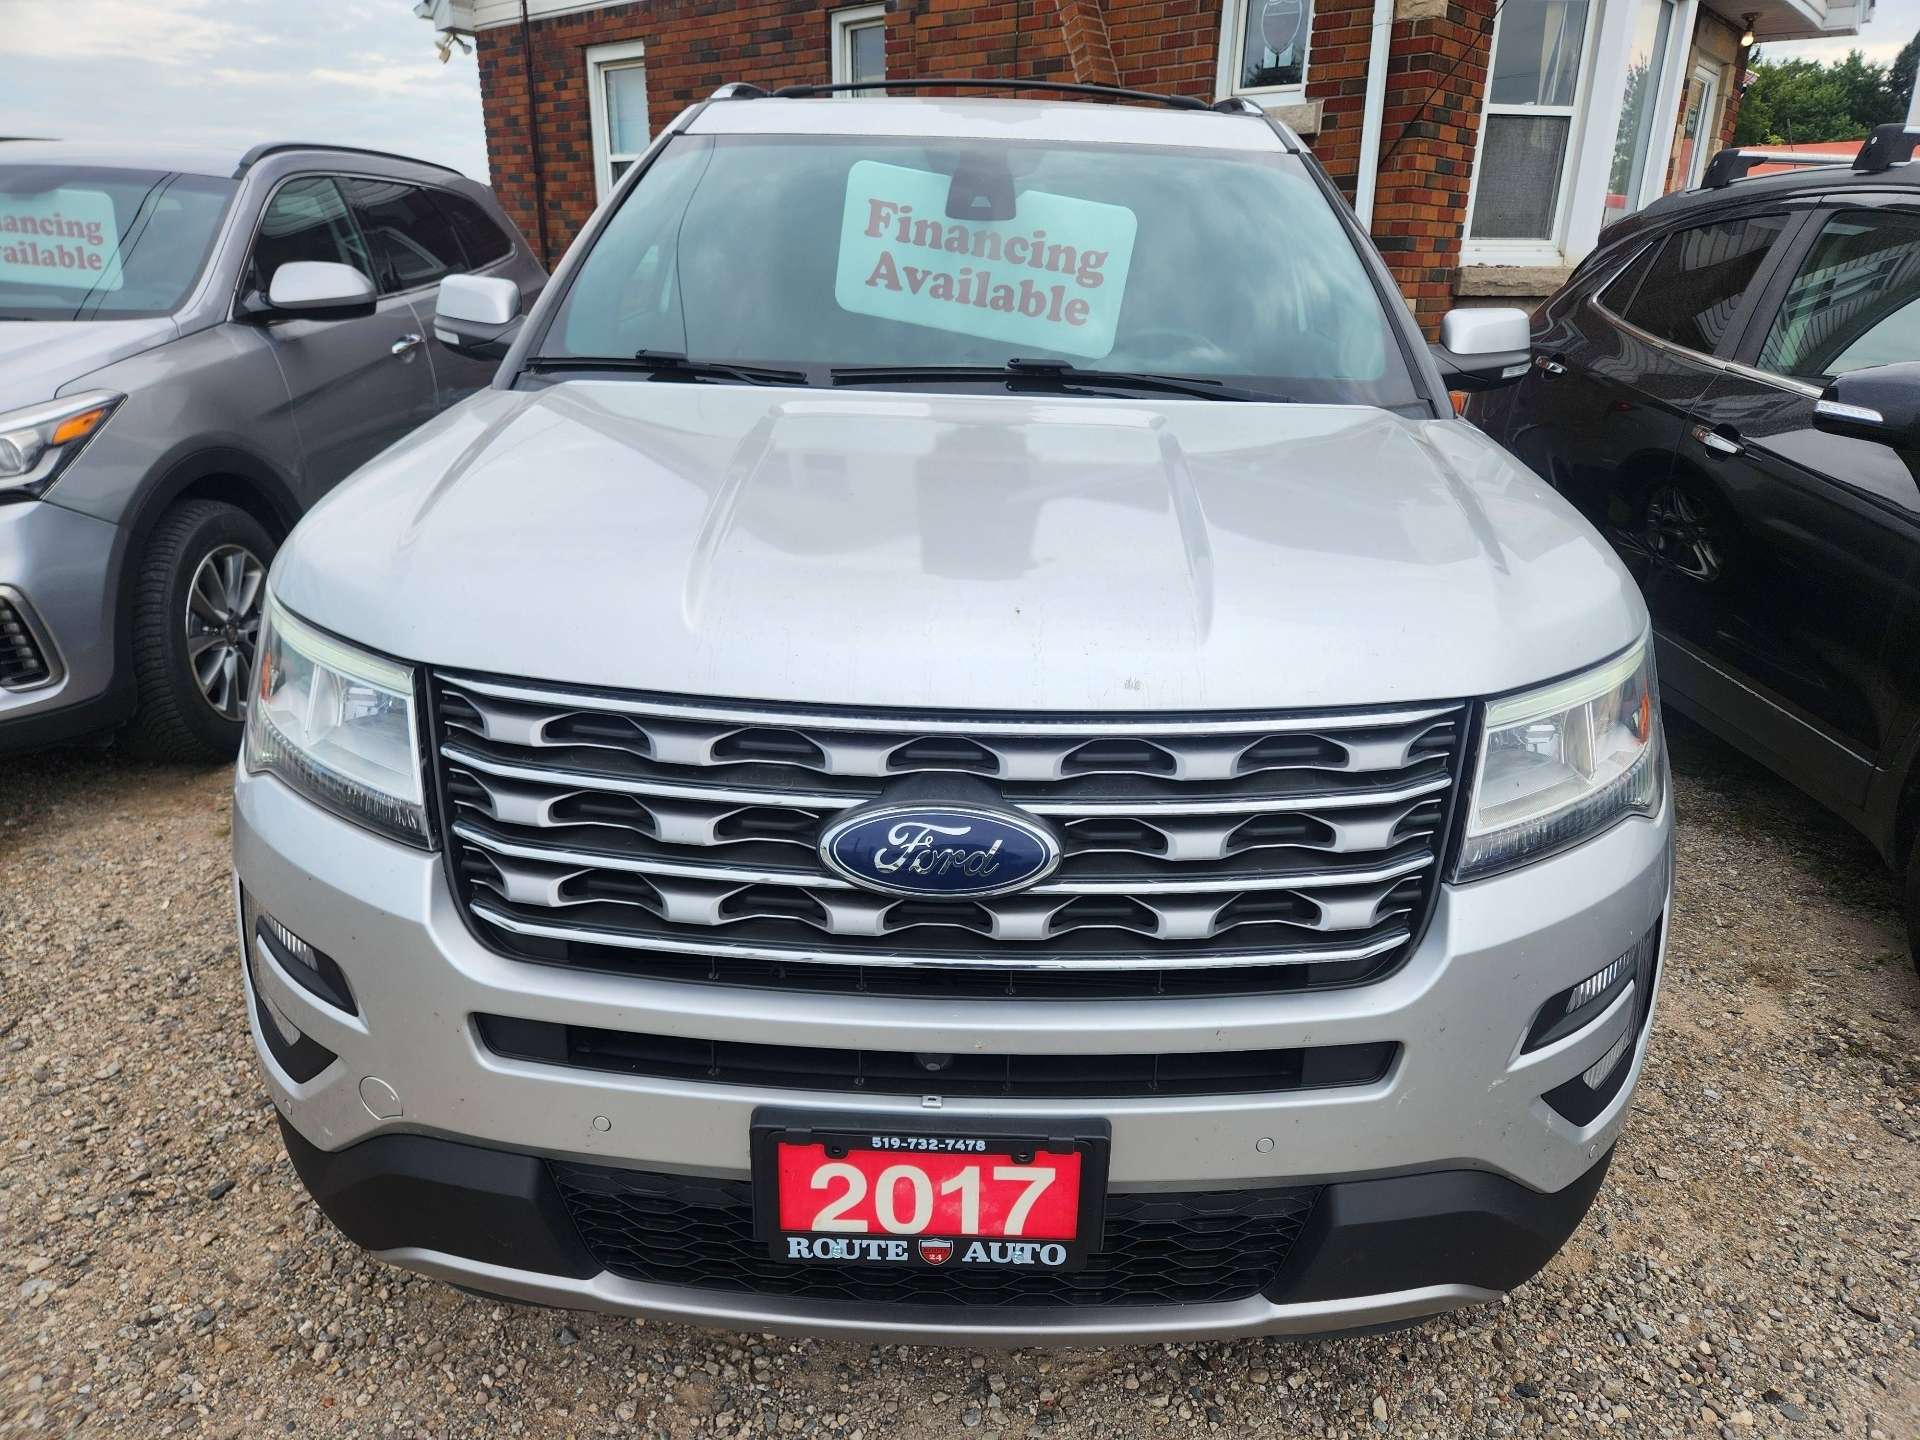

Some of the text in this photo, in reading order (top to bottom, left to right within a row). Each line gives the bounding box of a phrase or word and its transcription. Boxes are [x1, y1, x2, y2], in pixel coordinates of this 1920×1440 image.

[0, 212, 104, 246] ancing
[864, 198, 1109, 289] Financing
[0, 240, 102, 271] ailable
[865, 250, 1090, 326] Available
[874, 822, 1003, 877] Ford
[871, 1136, 986, 1152] 519-732-7478
[810, 1162, 1056, 1236] 2017
[787, 1236, 909, 1261] ROUTE
[962, 1241, 1067, 1266] AUTO
